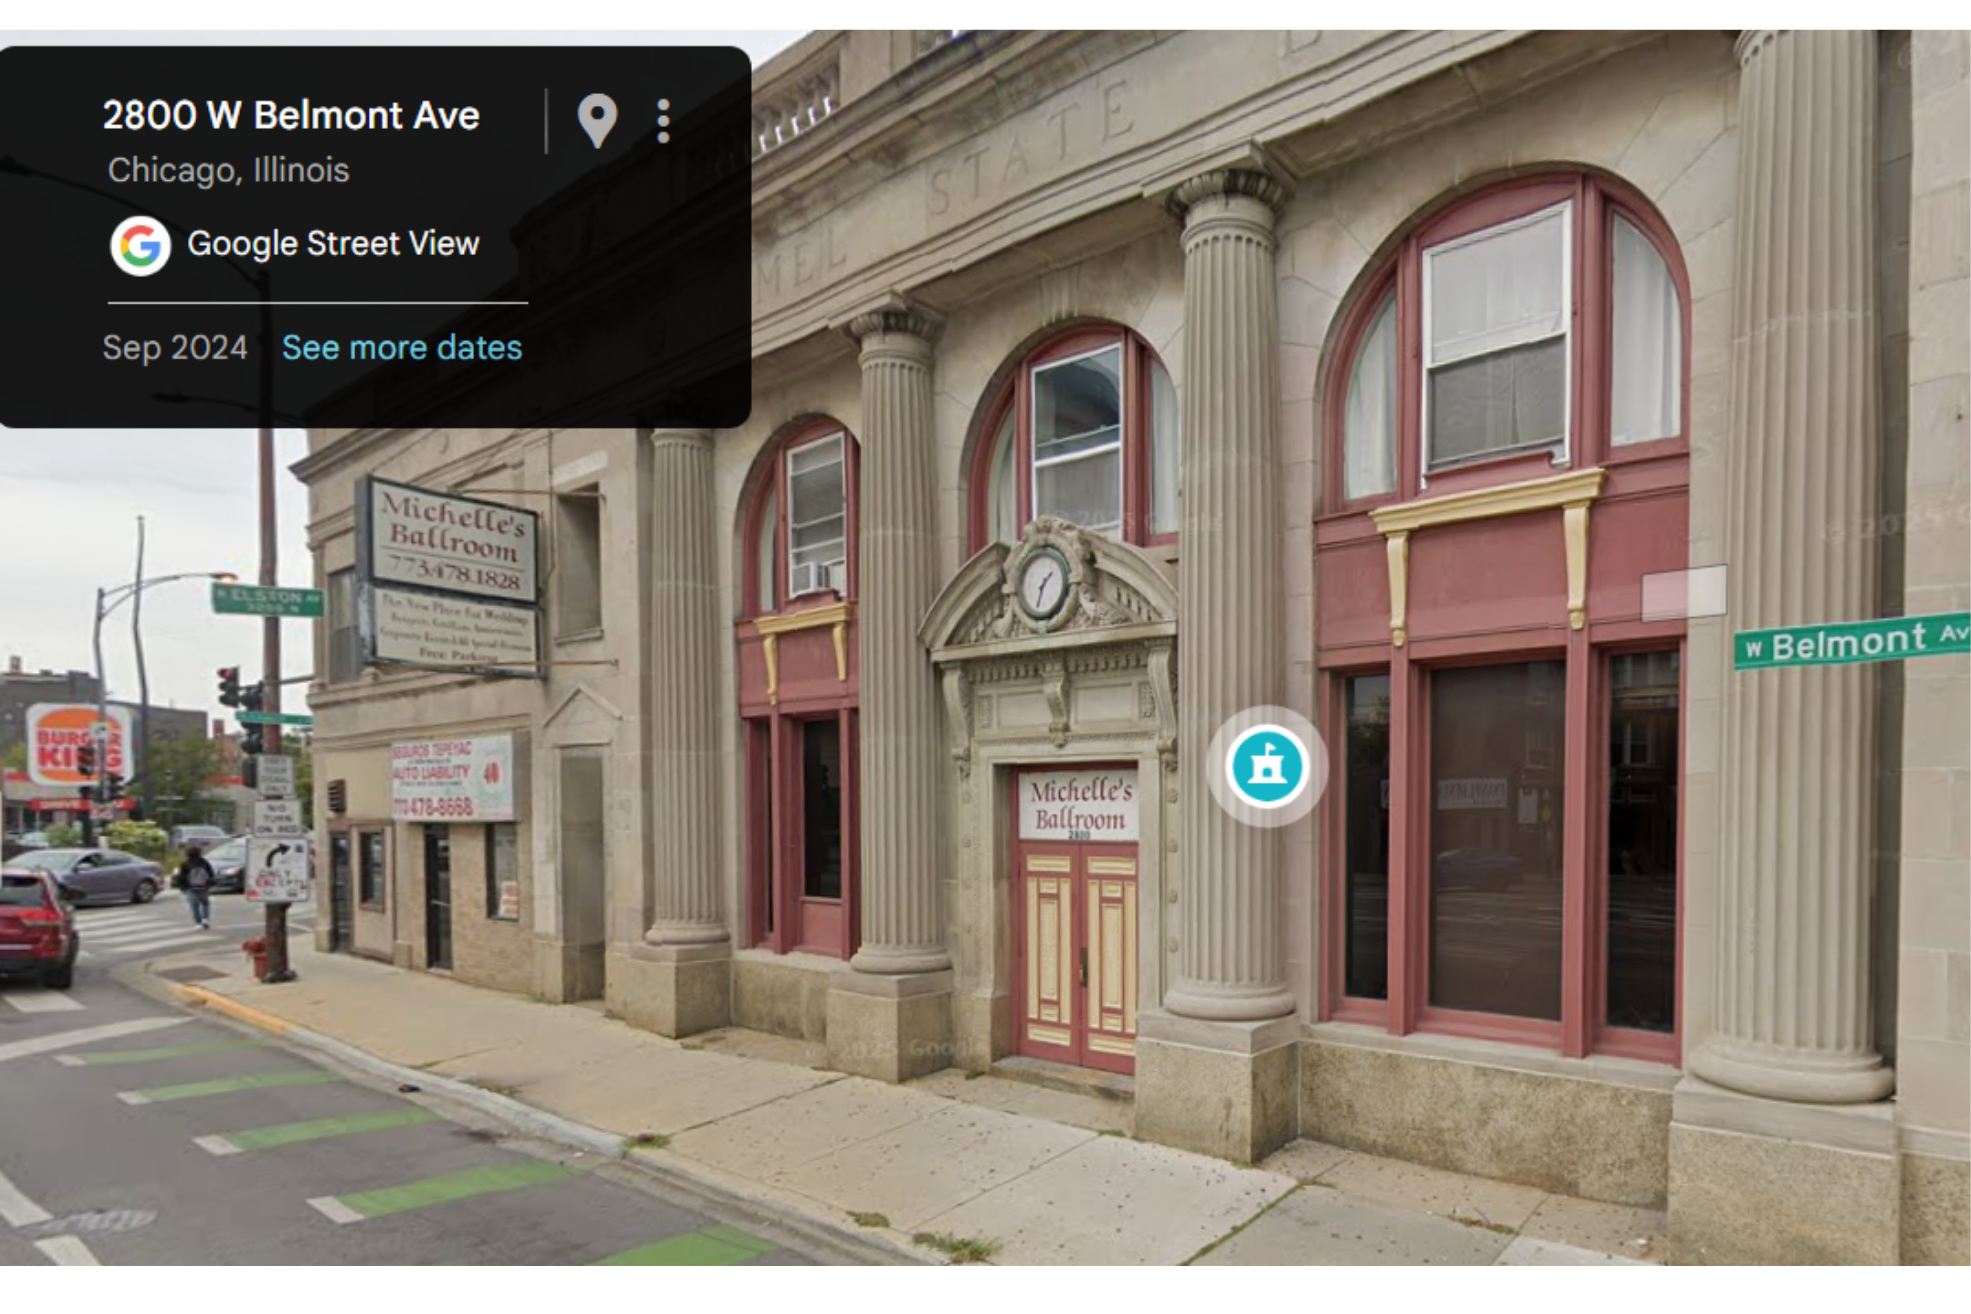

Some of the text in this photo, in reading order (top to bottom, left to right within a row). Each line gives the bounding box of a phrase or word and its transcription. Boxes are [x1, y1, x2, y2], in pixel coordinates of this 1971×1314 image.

[928, 79, 1135, 218] STATE
[382, 491, 527, 539] Michelle's
[390, 522, 519, 563] Ballroom
[230, 586, 303, 604] ELSTON
[1746, 641, 1763, 658] W
[1773, 622, 1927, 662] Belmont
[38, 729, 122, 747] BURGR
[38, 746, 123, 768] KIG
[393, 763, 471, 781] AUTO LIABILITY
[1031, 775, 1133, 802] Michelle's
[263, 814, 293, 823] TURN
[267, 804, 286, 813] NO
[1035, 805, 1127, 830] Ballroom
[257, 825, 297, 834] ON RED
